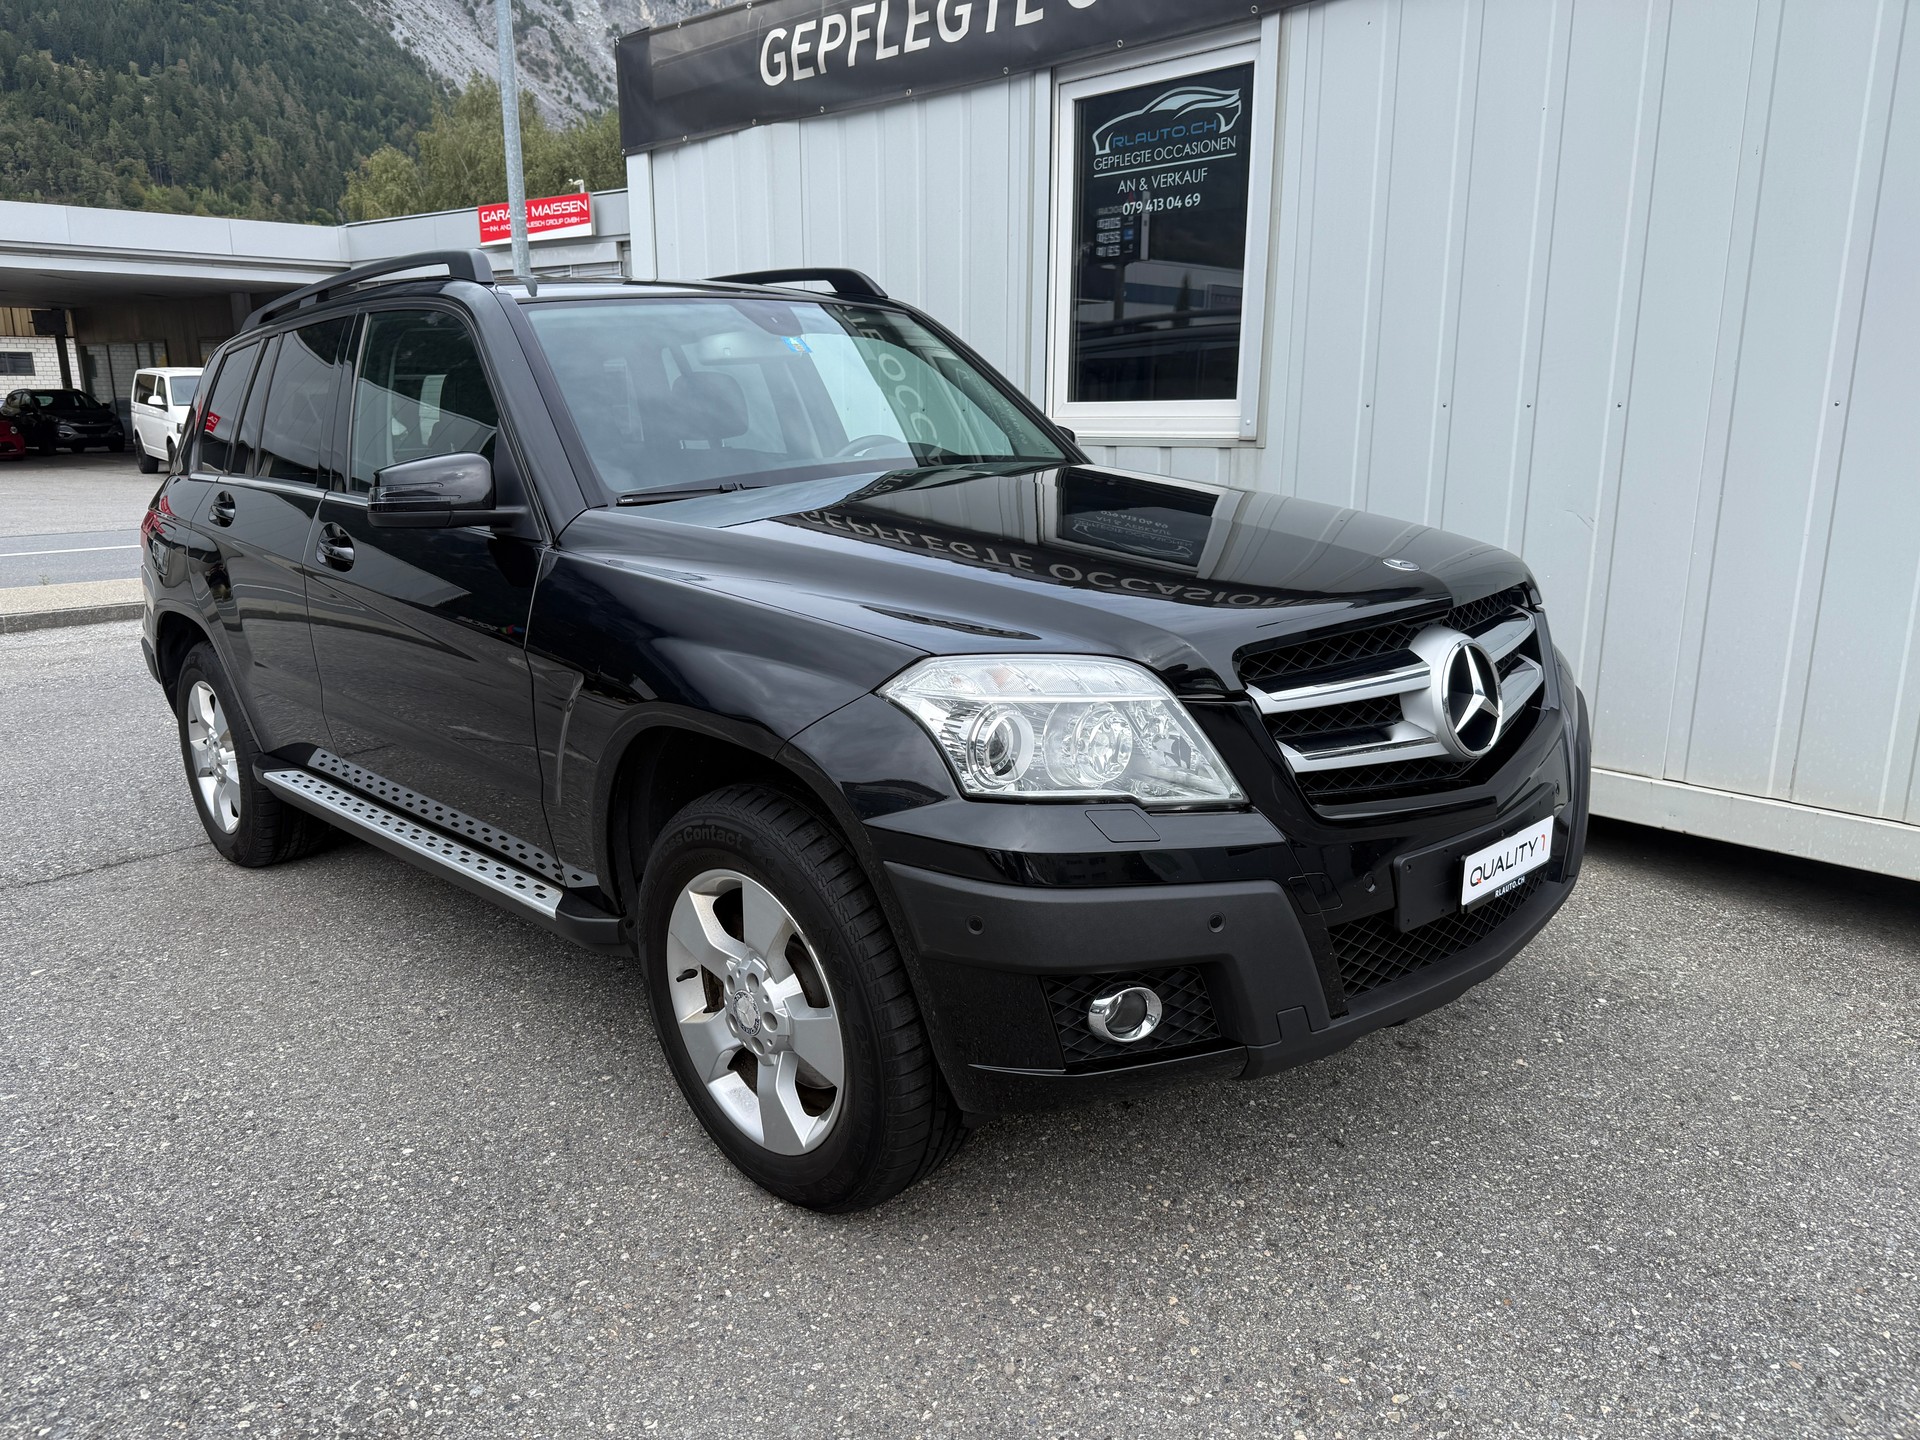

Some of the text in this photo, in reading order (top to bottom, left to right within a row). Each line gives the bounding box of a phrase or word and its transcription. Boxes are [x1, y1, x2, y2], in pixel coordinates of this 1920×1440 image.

[1112, 119, 1218, 149] RLAUTO.CH
[1093, 135, 1237, 171] GEPFLEGTE OCCASIONEN
[1117, 167, 1209, 194] AN & VERKAUF
[481, 199, 588, 223] GARA MAISSEN
[1122, 200, 1143, 216] 079
[1145, 198, 1164, 213] 413
[1166, 196, 1182, 210] 04
[1184, 193, 1201, 208] 69
[1470, 836, 1538, 887] QUALITY
[1495, 875, 1526, 898] RLAUTO.CH
